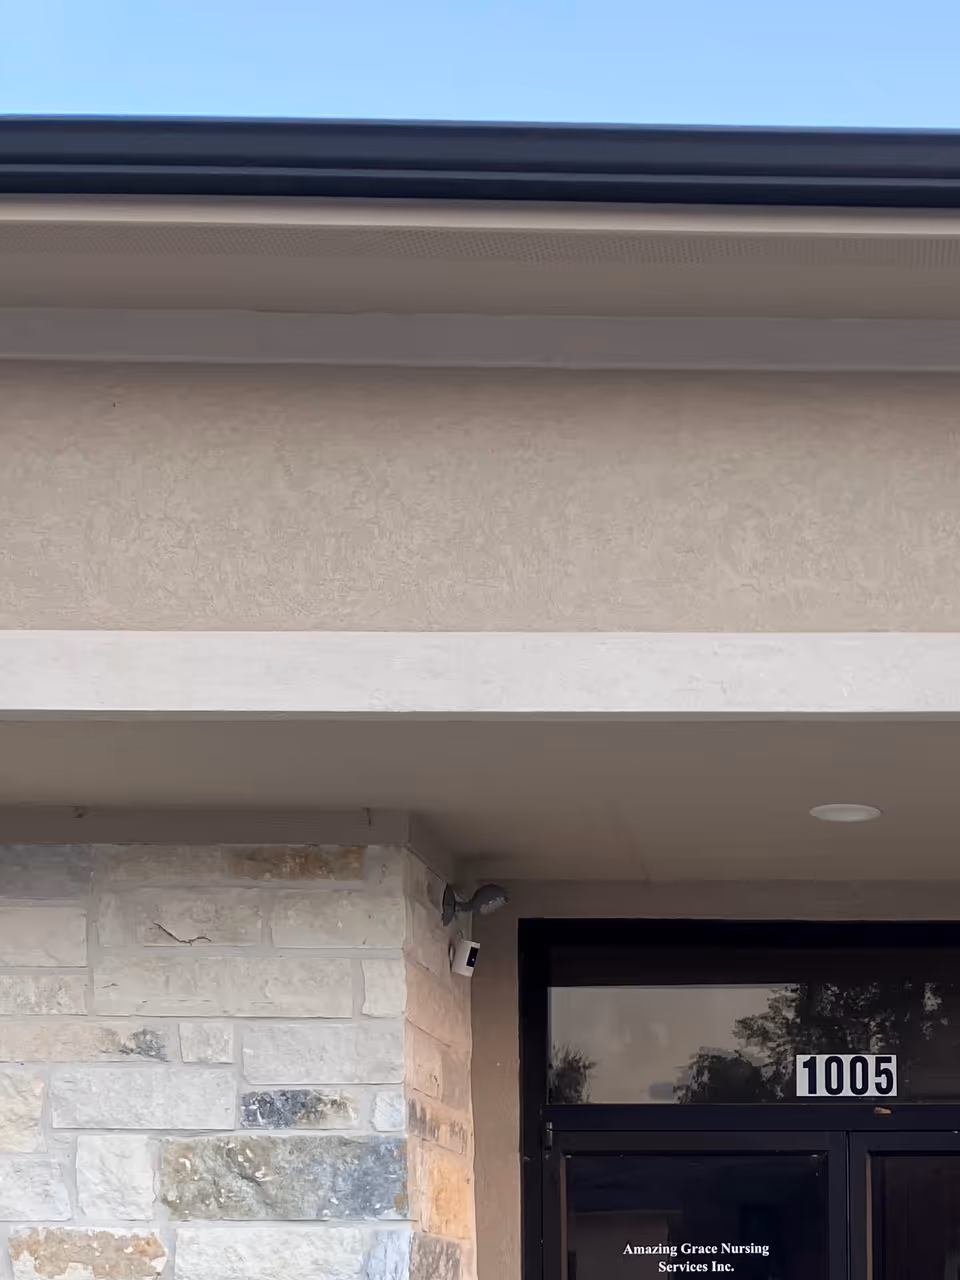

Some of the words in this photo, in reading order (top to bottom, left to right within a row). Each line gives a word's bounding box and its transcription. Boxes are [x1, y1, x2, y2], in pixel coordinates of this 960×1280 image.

[802, 1056, 894, 1096] 1005
[623, 1243, 678, 1257] Amazing
[680, 1243, 718, 1255] Grace
[721, 1242, 770, 1256] Nursing
[658, 1260, 709, 1273] Services
[712, 1260, 735, 1272] Inc.
